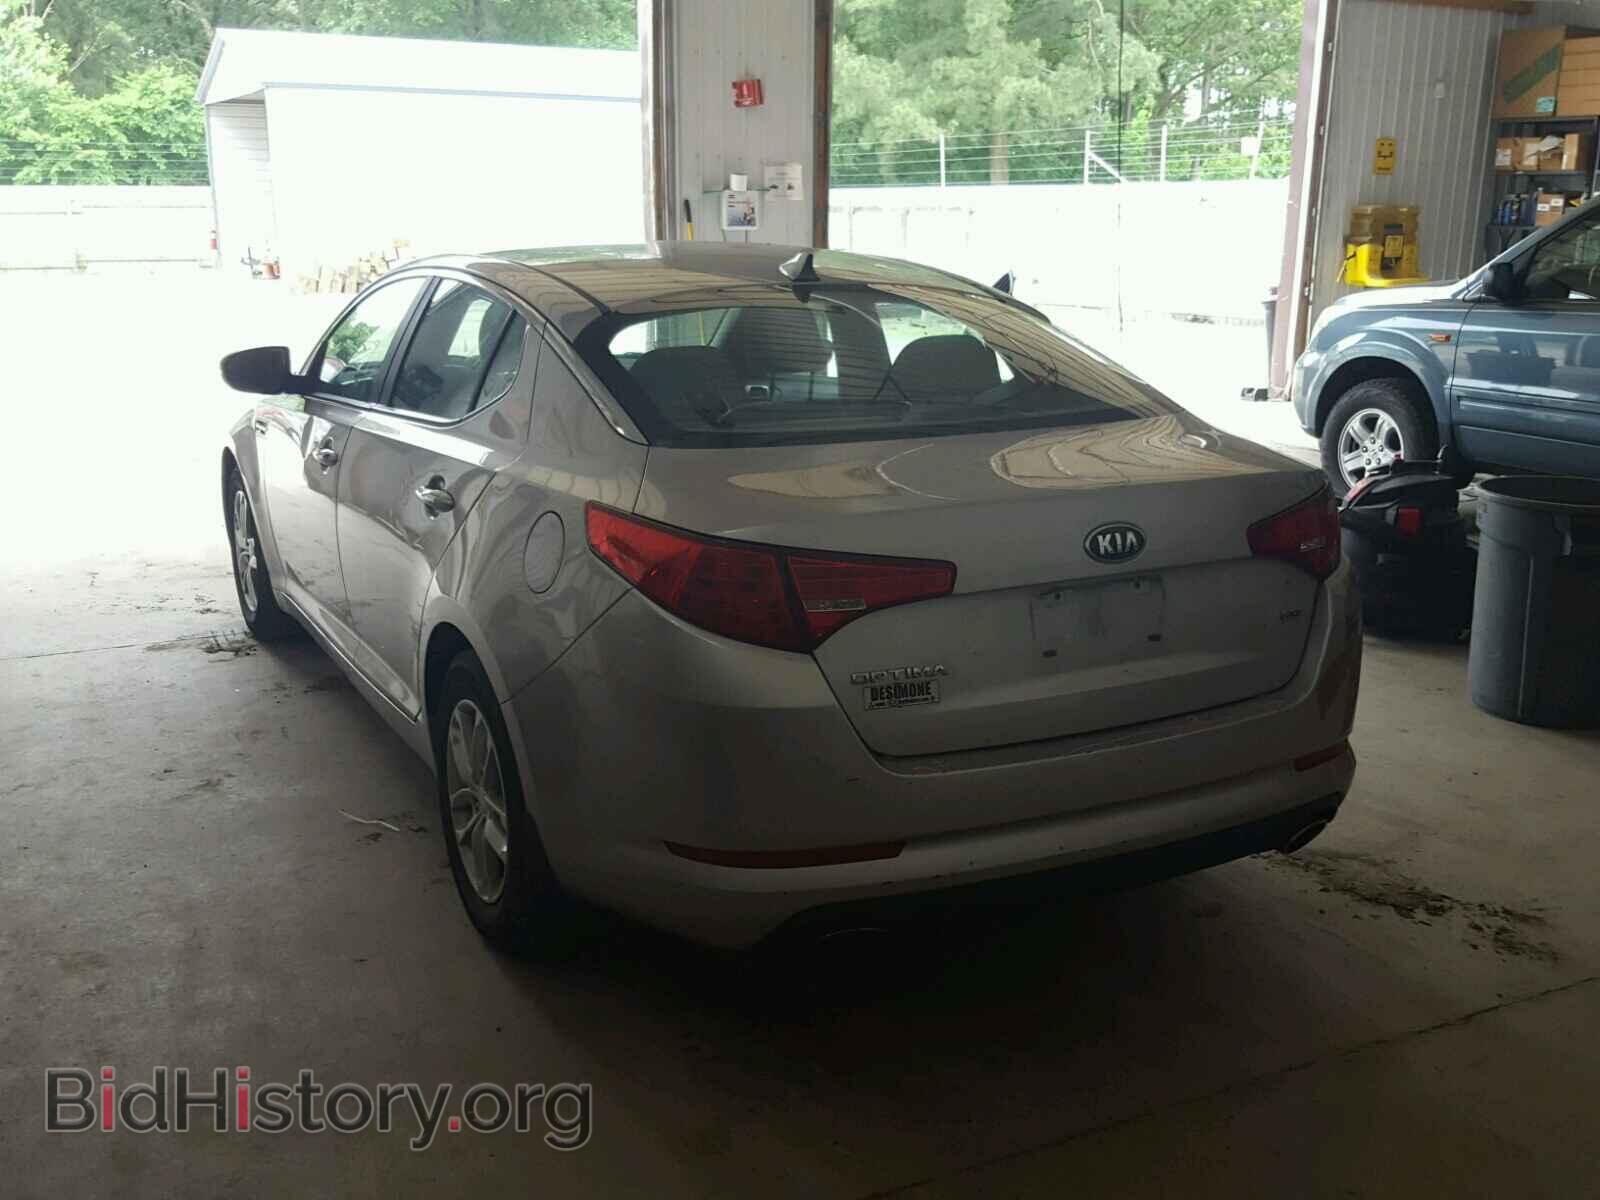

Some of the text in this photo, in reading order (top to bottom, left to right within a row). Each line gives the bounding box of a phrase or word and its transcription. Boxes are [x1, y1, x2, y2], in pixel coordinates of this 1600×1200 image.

[1096, 530, 1138, 555] KIA
[850, 664, 949, 683] OPTIMA
[870, 681, 932, 701] DESIMONE
